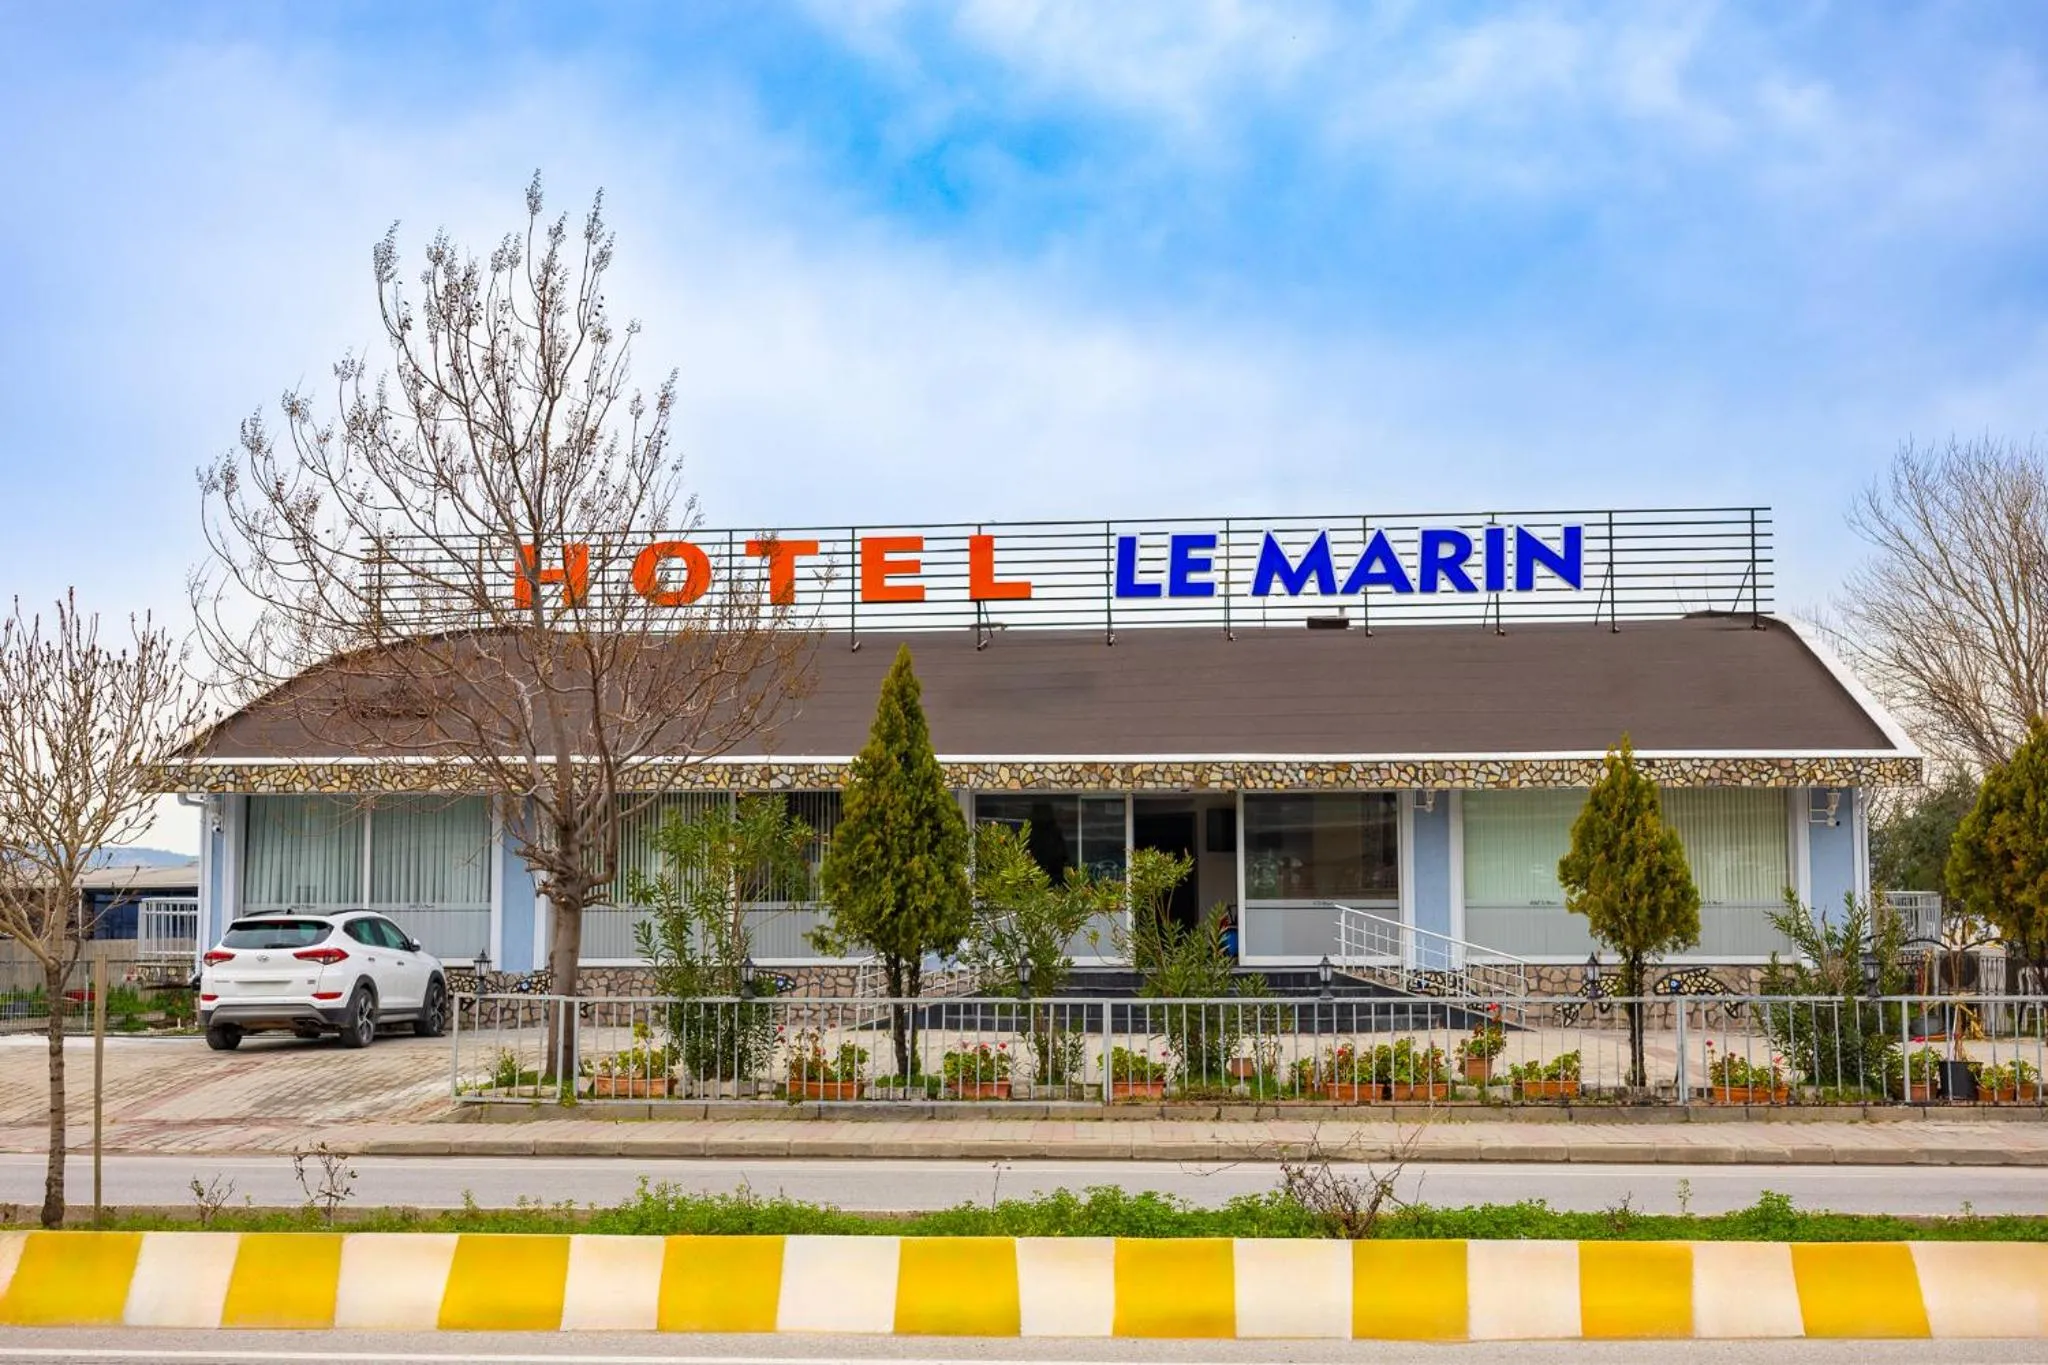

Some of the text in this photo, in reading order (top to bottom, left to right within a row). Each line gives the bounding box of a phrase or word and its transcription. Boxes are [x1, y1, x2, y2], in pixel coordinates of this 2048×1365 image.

[515, 525, 1584, 608] HOTEL LE MARIN
